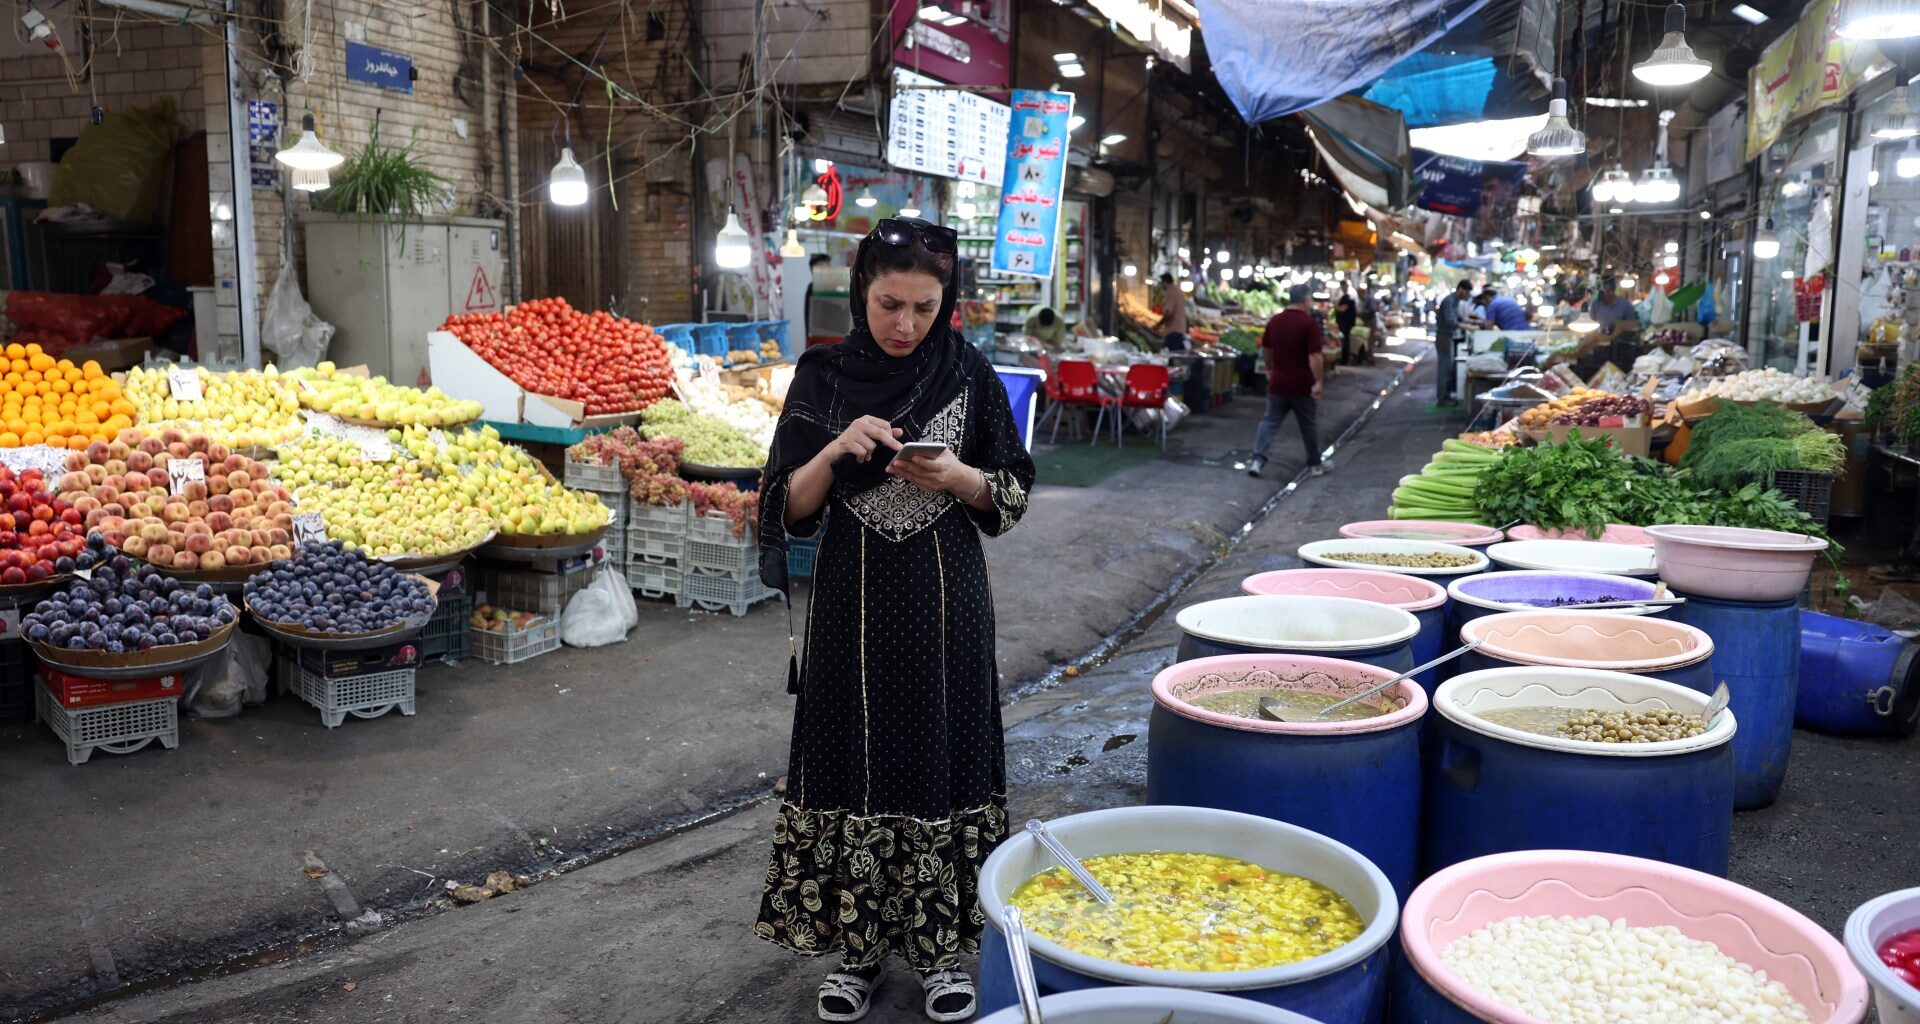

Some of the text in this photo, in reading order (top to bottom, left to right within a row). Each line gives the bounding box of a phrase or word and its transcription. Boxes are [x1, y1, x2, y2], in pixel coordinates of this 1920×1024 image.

[1011, 136, 1060, 161] شیر موز
[1024, 167, 1041, 180] ۸۰
[1421, 169, 1446, 183] VIP
[1020, 211, 1036, 225] ۷۰
[1014, 253, 1030, 268] ۶۰
